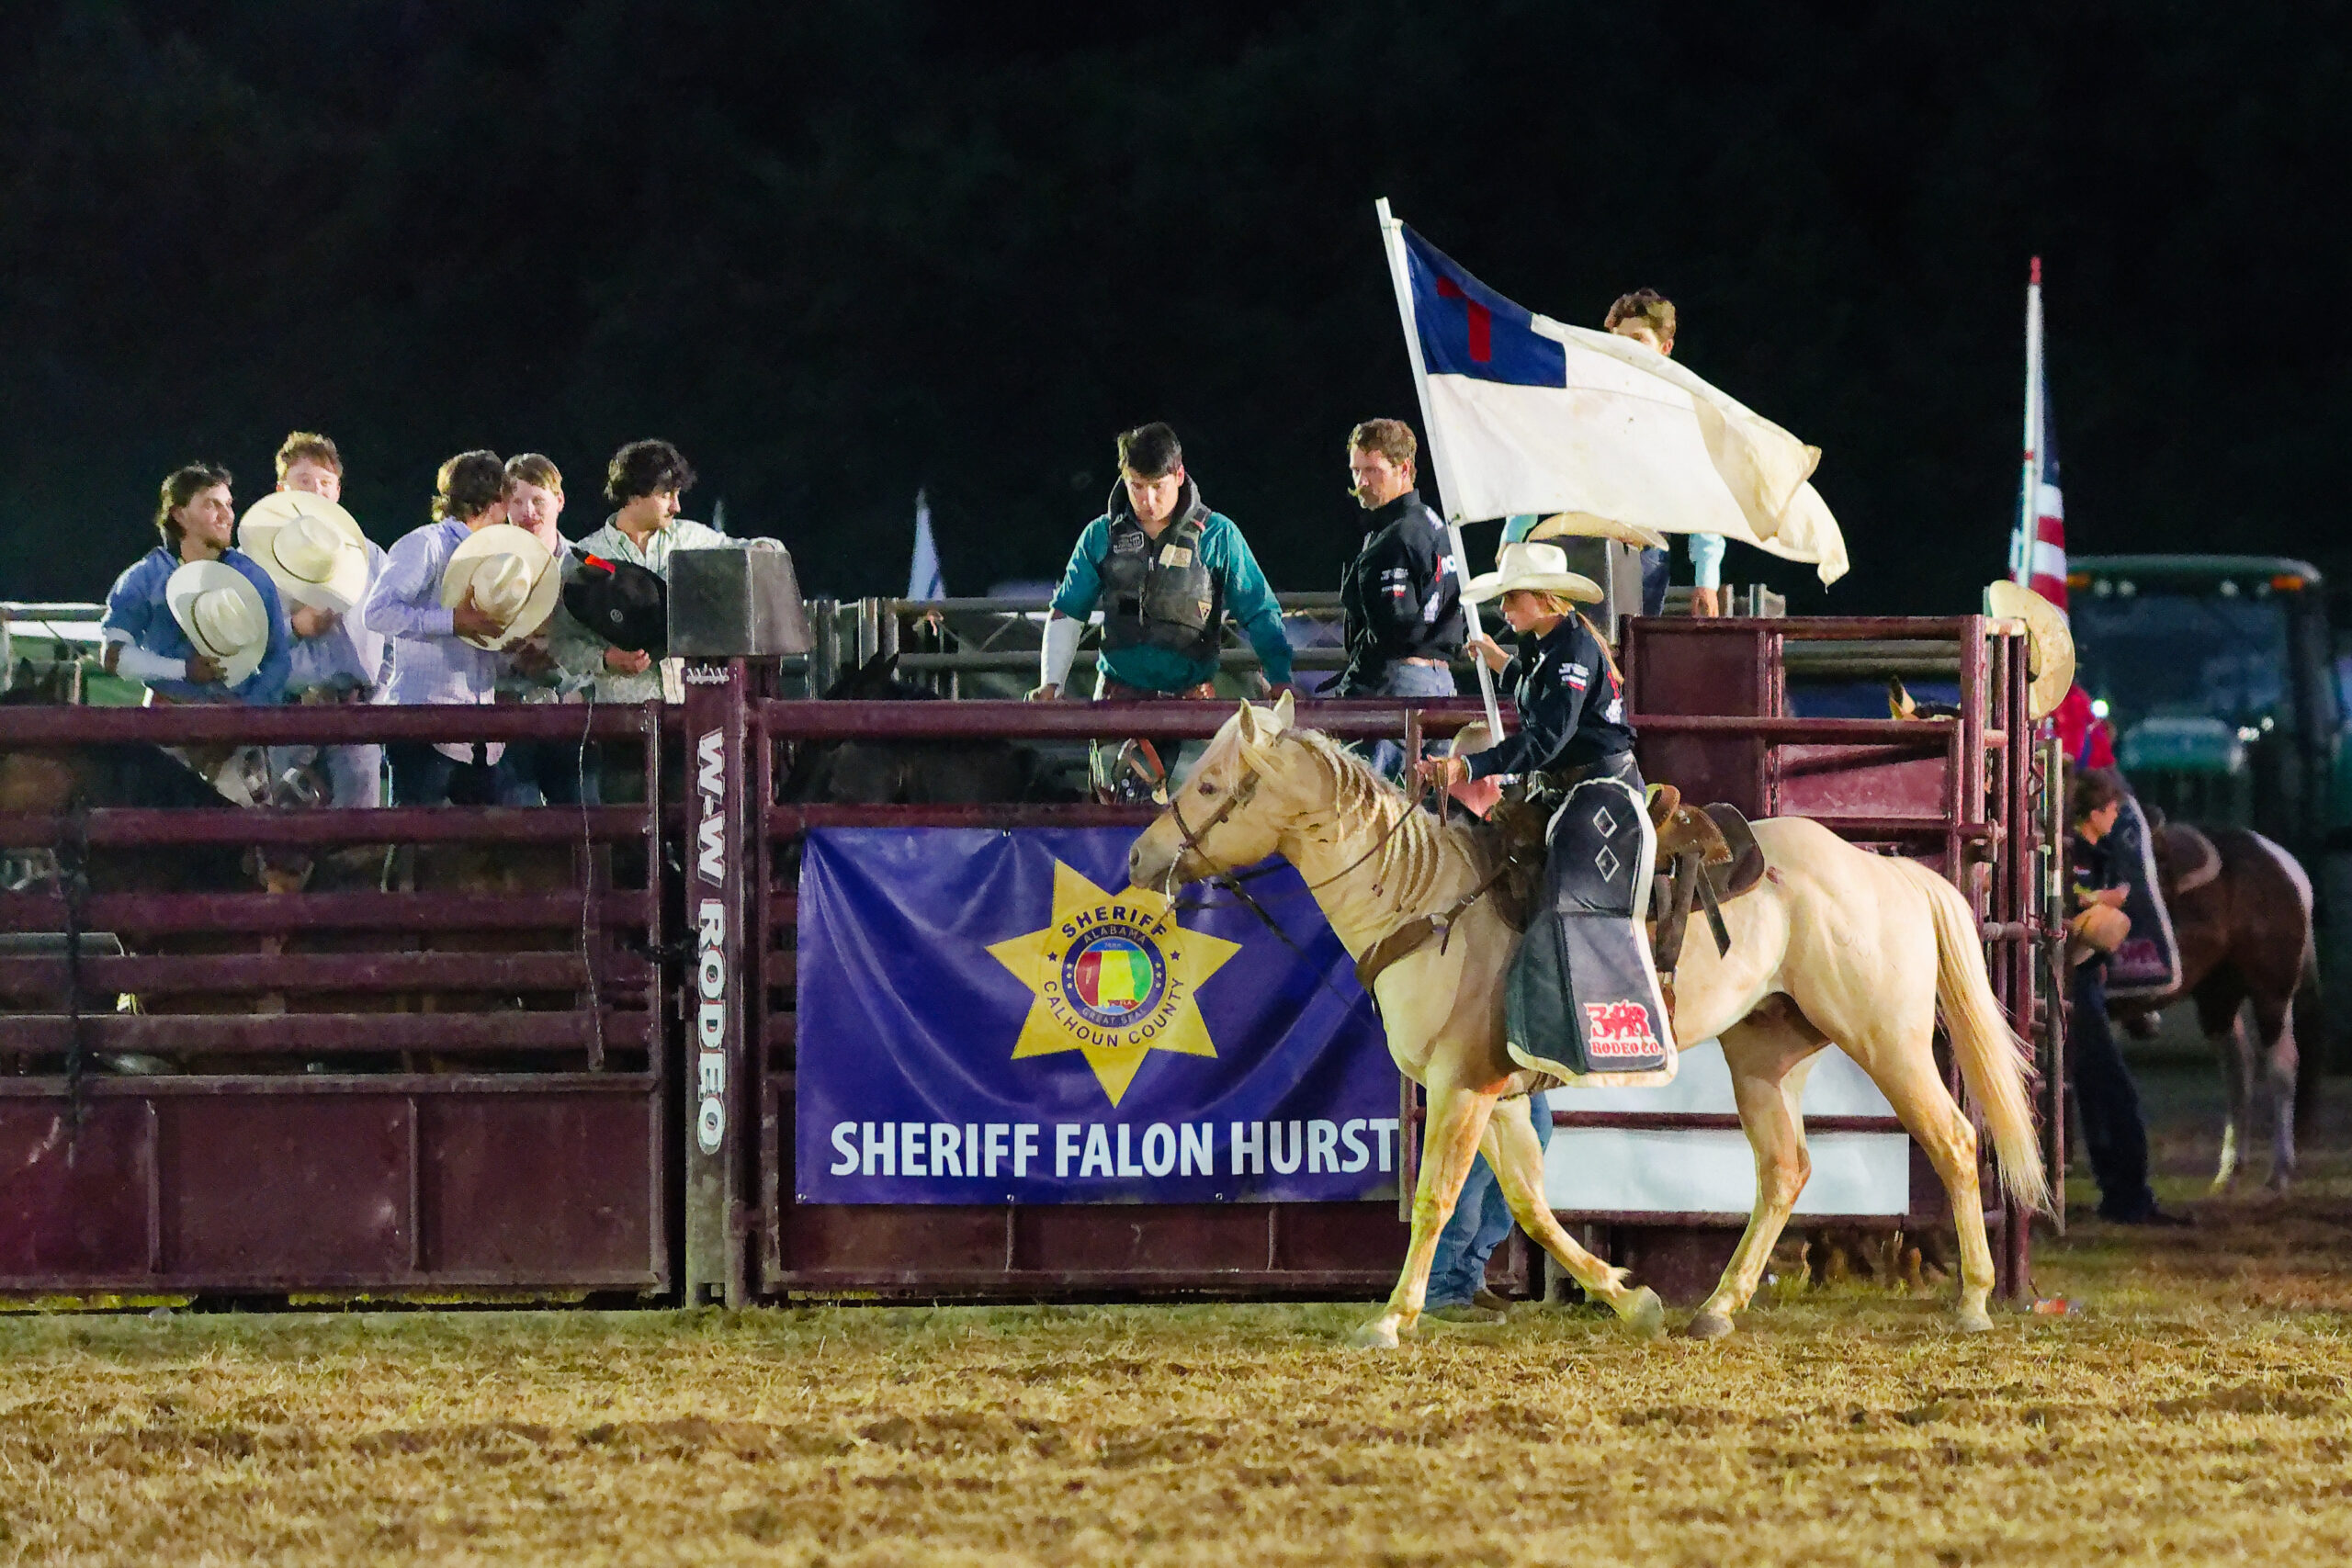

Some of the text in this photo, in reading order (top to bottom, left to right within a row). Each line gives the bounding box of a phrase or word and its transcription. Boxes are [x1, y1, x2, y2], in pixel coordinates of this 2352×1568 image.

[698, 726, 726, 1156] W-W RODEO
[1061, 906, 1168, 938] SHERIFF
[1084, 925, 1146, 944] ALABAMA
[1044, 977, 1184, 1047] CALHOUN COUNTY
[1591, 1041, 1639, 1055] RODEO
[830, 1118, 1400, 1178] SHERIFF FALON HURST
